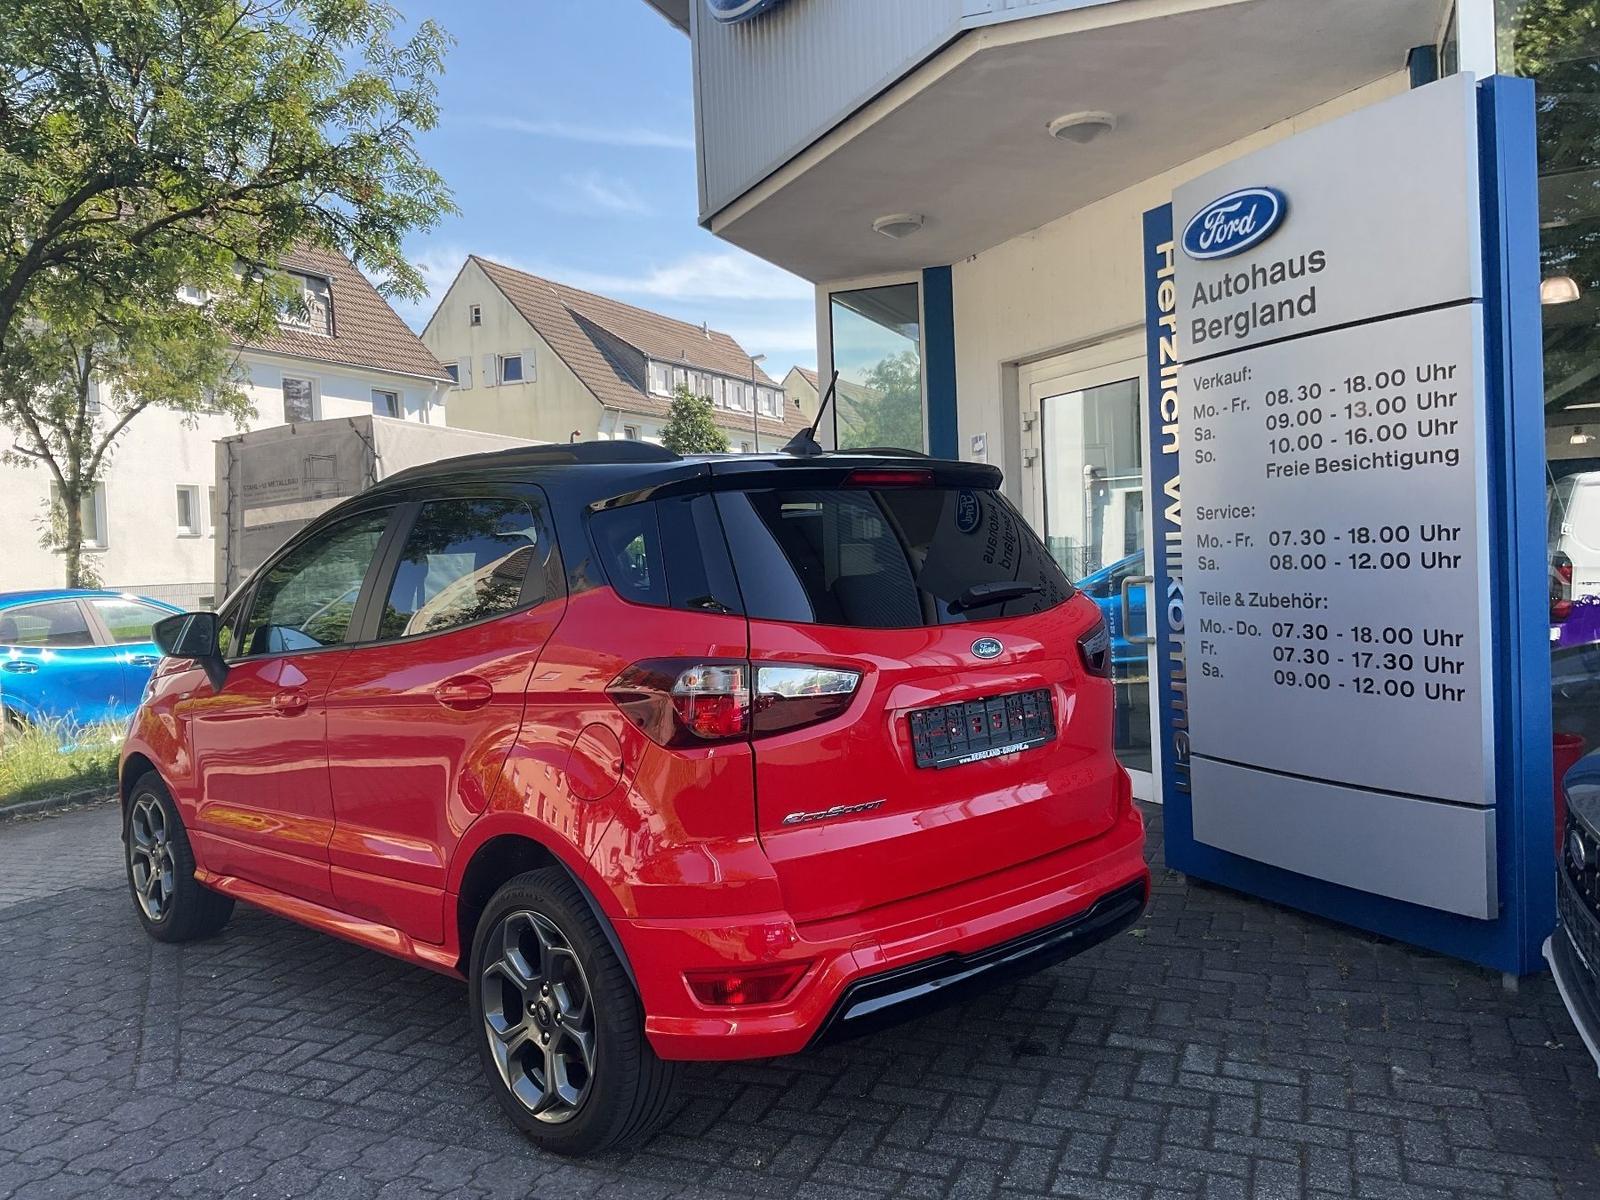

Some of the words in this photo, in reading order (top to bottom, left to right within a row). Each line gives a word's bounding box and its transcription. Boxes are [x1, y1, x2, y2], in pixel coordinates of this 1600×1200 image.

[1200, 201, 1257, 249] Ford
[1191, 250, 1326, 309] Autohaus
[1191, 286, 1316, 344] Bergland
[1193, 366, 1252, 391] Verkauf:
[1265, 383, 1322, 407] 08.30
[1343, 369, 1406, 394] 18.00
[1416, 363, 1457, 383] Uhr
[1194, 427, 1216, 441] Sa.
[1266, 408, 1322, 431] 09.00
[1344, 396, 1406, 420] 13.00
[1417, 391, 1457, 410] Uhr
[1195, 449, 1216, 464] So.
[1268, 433, 1323, 454] 10.00
[1345, 422, 1407, 446] 16.00
[1418, 418, 1458, 438] Uhr
[1266, 460, 1310, 478] Freie
[1315, 448, 1460, 474] Besichtigung
[1196, 504, 1255, 520] Service:
[1269, 529, 1326, 546] 07.30
[1348, 525, 1410, 544] 18.00
[1420, 524, 1461, 542] Uhr
[1198, 556, 1220, 571] Sa.
[1270, 554, 1326, 571] 08.00
[1348, 552, 1411, 570] 12.00
[1421, 551, 1461, 569] Uhr
[1199, 591, 1231, 606] Teile
[1234, 592, 1246, 607] &
[1248, 592, 1328, 609] Zubehör:
[1272, 622, 1328, 640] 07.30
[1350, 626, 1413, 645] 18.00
[1423, 628, 1464, 647] Uhr
[1200, 640, 1217, 656] Fr.
[1273, 646, 1330, 666] 07.30
[1351, 651, 1414, 671] 17.30
[1424, 655, 1465, 675] Uhr
[1202, 662, 1224, 678] Sa.
[1274, 670, 1331, 690] 09.00
[1352, 677, 1415, 698] 12.00
[1425, 682, 1466, 702] Uhr
